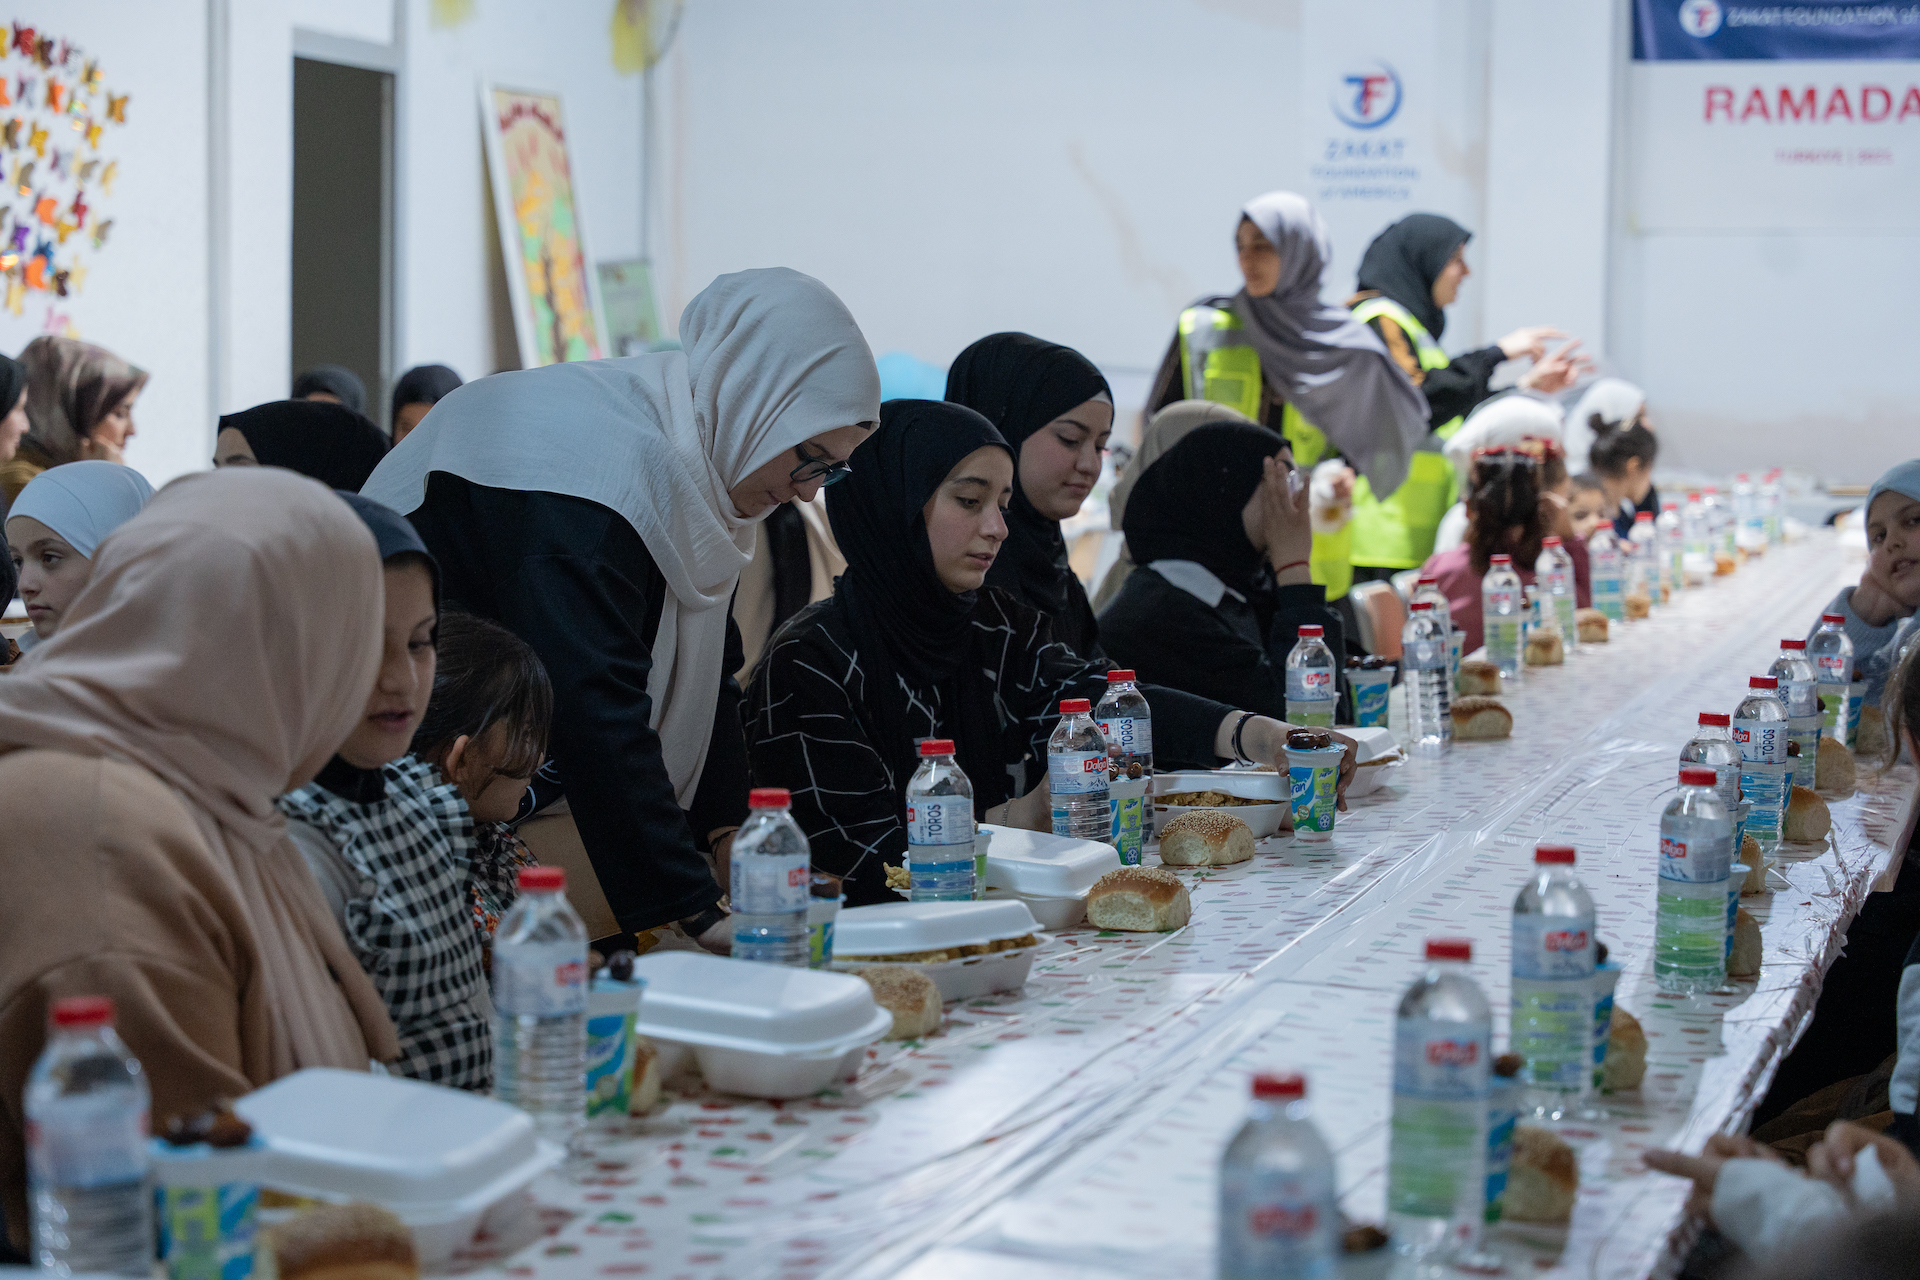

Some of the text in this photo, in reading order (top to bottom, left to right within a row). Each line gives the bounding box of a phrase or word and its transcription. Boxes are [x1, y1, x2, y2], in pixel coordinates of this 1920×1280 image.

[1704, 85, 1920, 123] RAMADA
[1120, 718, 1133, 747] TOROS
[1762, 728, 1775, 756] TOROS
[1085, 760, 1107, 772] Dalga
[927, 803, 943, 838] TOROS
